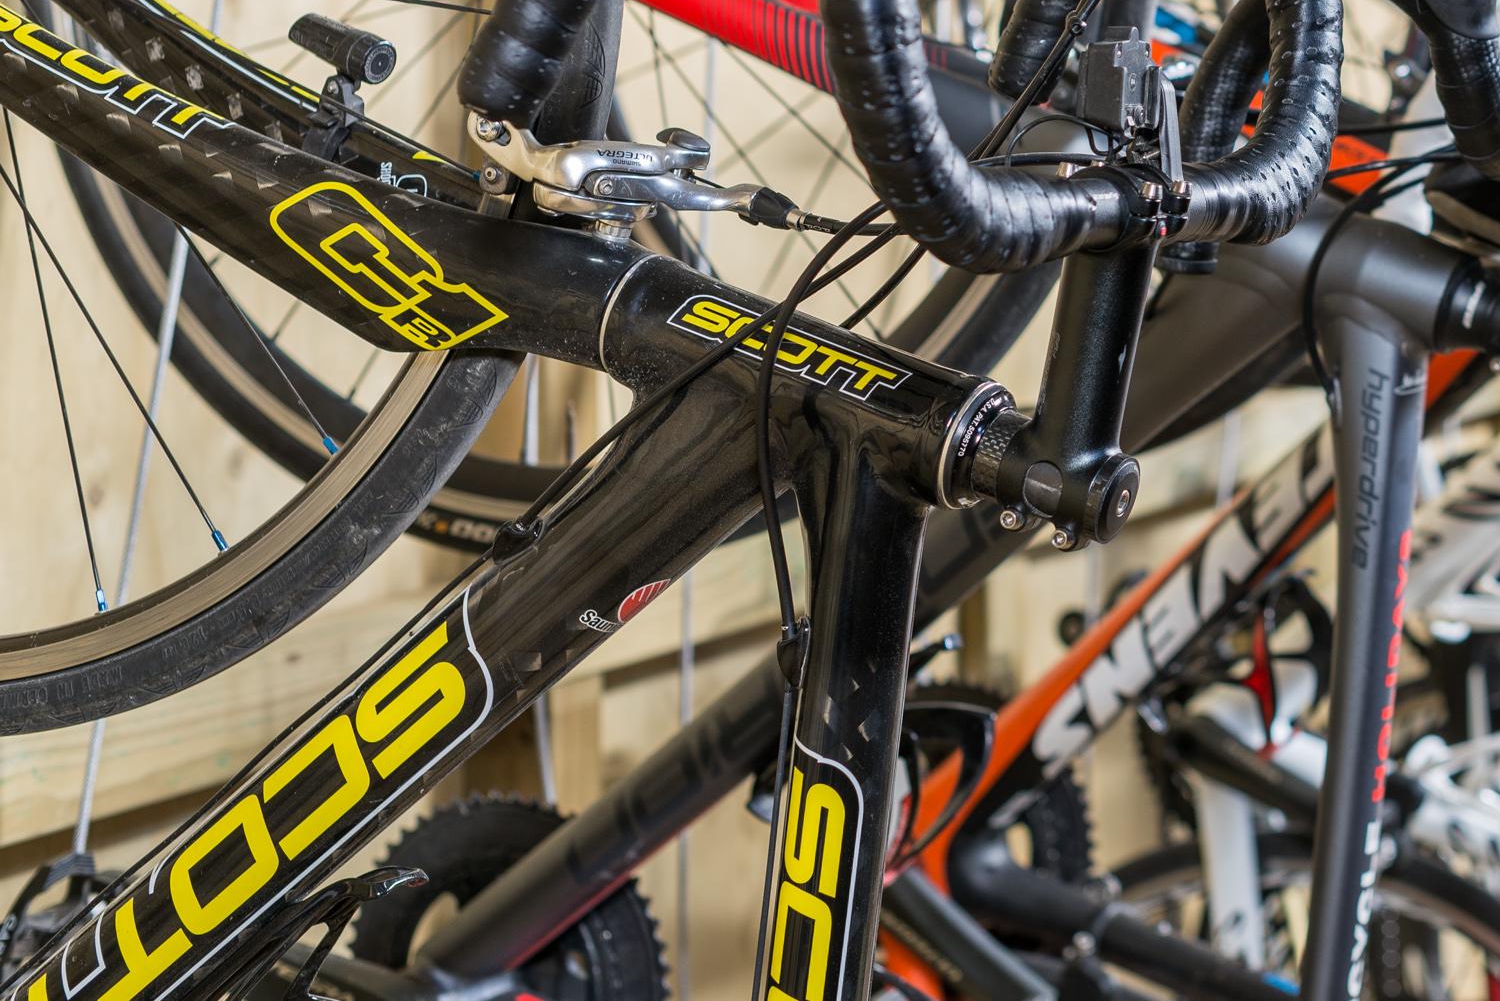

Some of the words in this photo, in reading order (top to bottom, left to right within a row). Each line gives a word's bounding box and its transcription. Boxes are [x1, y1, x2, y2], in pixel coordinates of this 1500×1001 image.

[597, 149, 654, 164] ULTEGRA
[682, 301, 898, 391] SCOTT
[1350, 367, 1390, 571] hyperdrive
[26, 621, 467, 1001] SCOT
[766, 766, 846, 1001] SC
